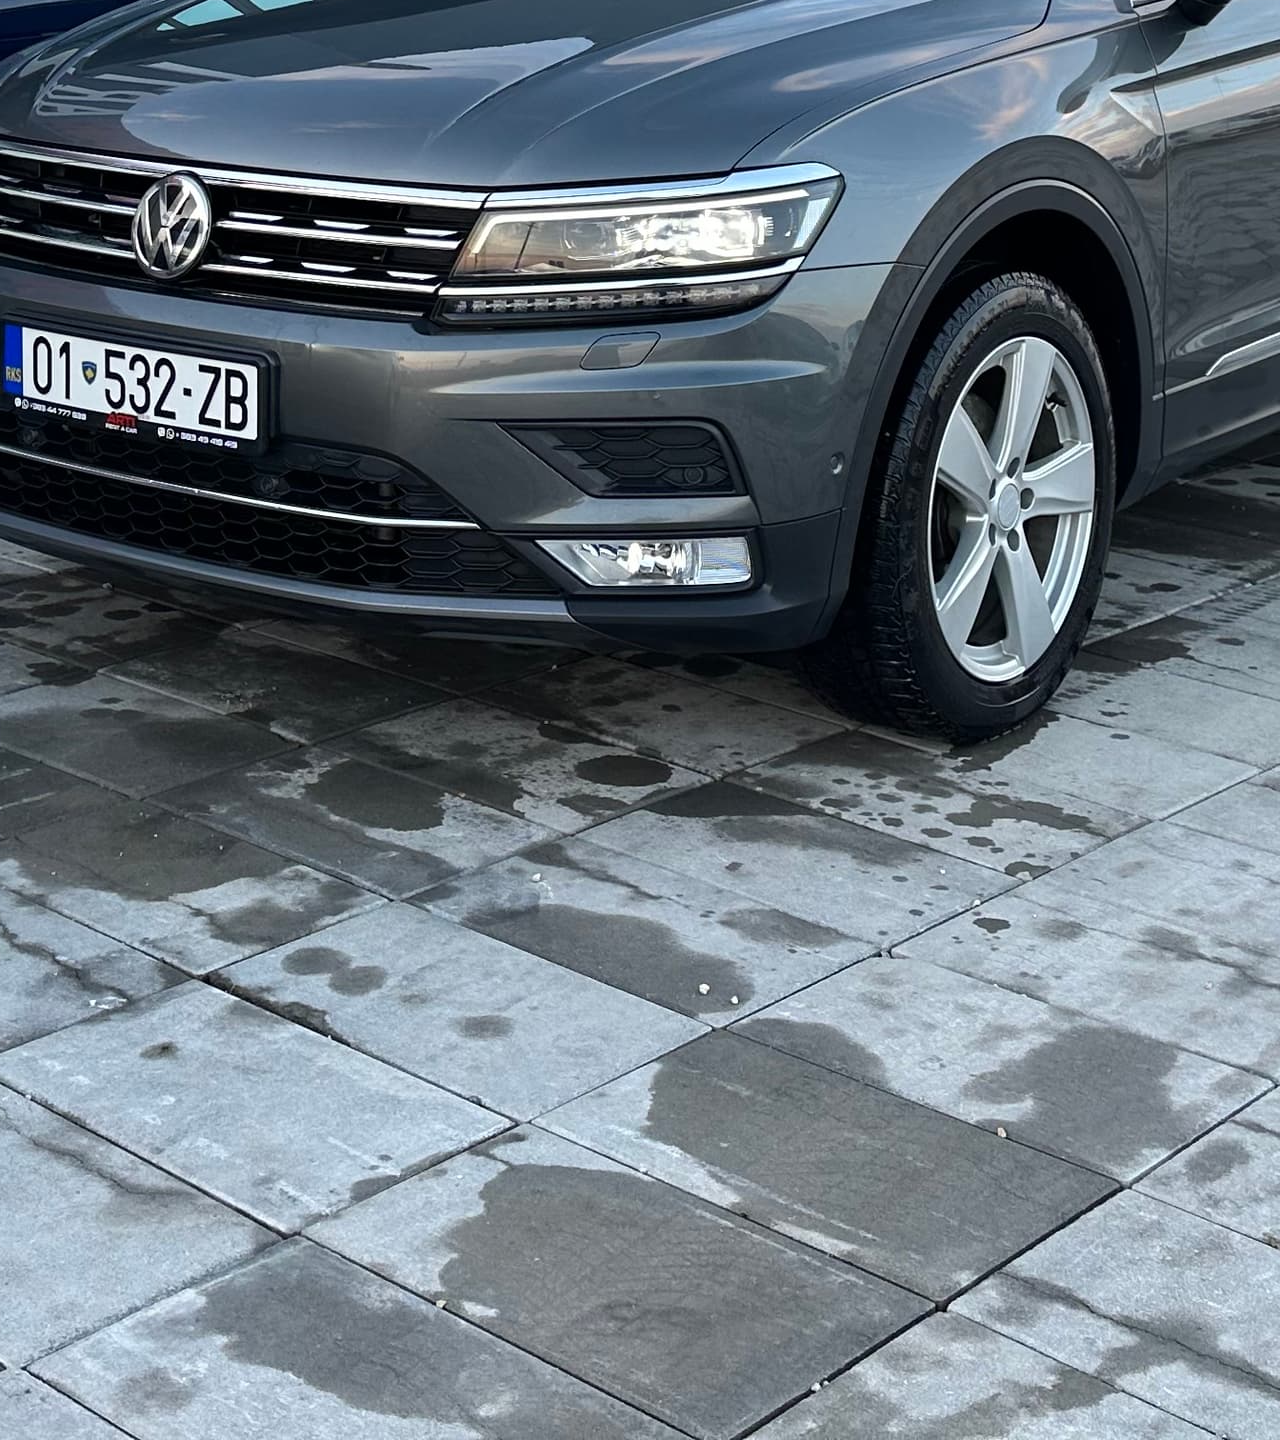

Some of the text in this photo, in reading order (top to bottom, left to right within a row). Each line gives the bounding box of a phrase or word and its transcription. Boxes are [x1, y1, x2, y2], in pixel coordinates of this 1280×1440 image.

[5, 366, 21, 383] RKS
[33, 336, 248, 431] 01 532-ZB
[107, 413, 136, 427] ARTI
